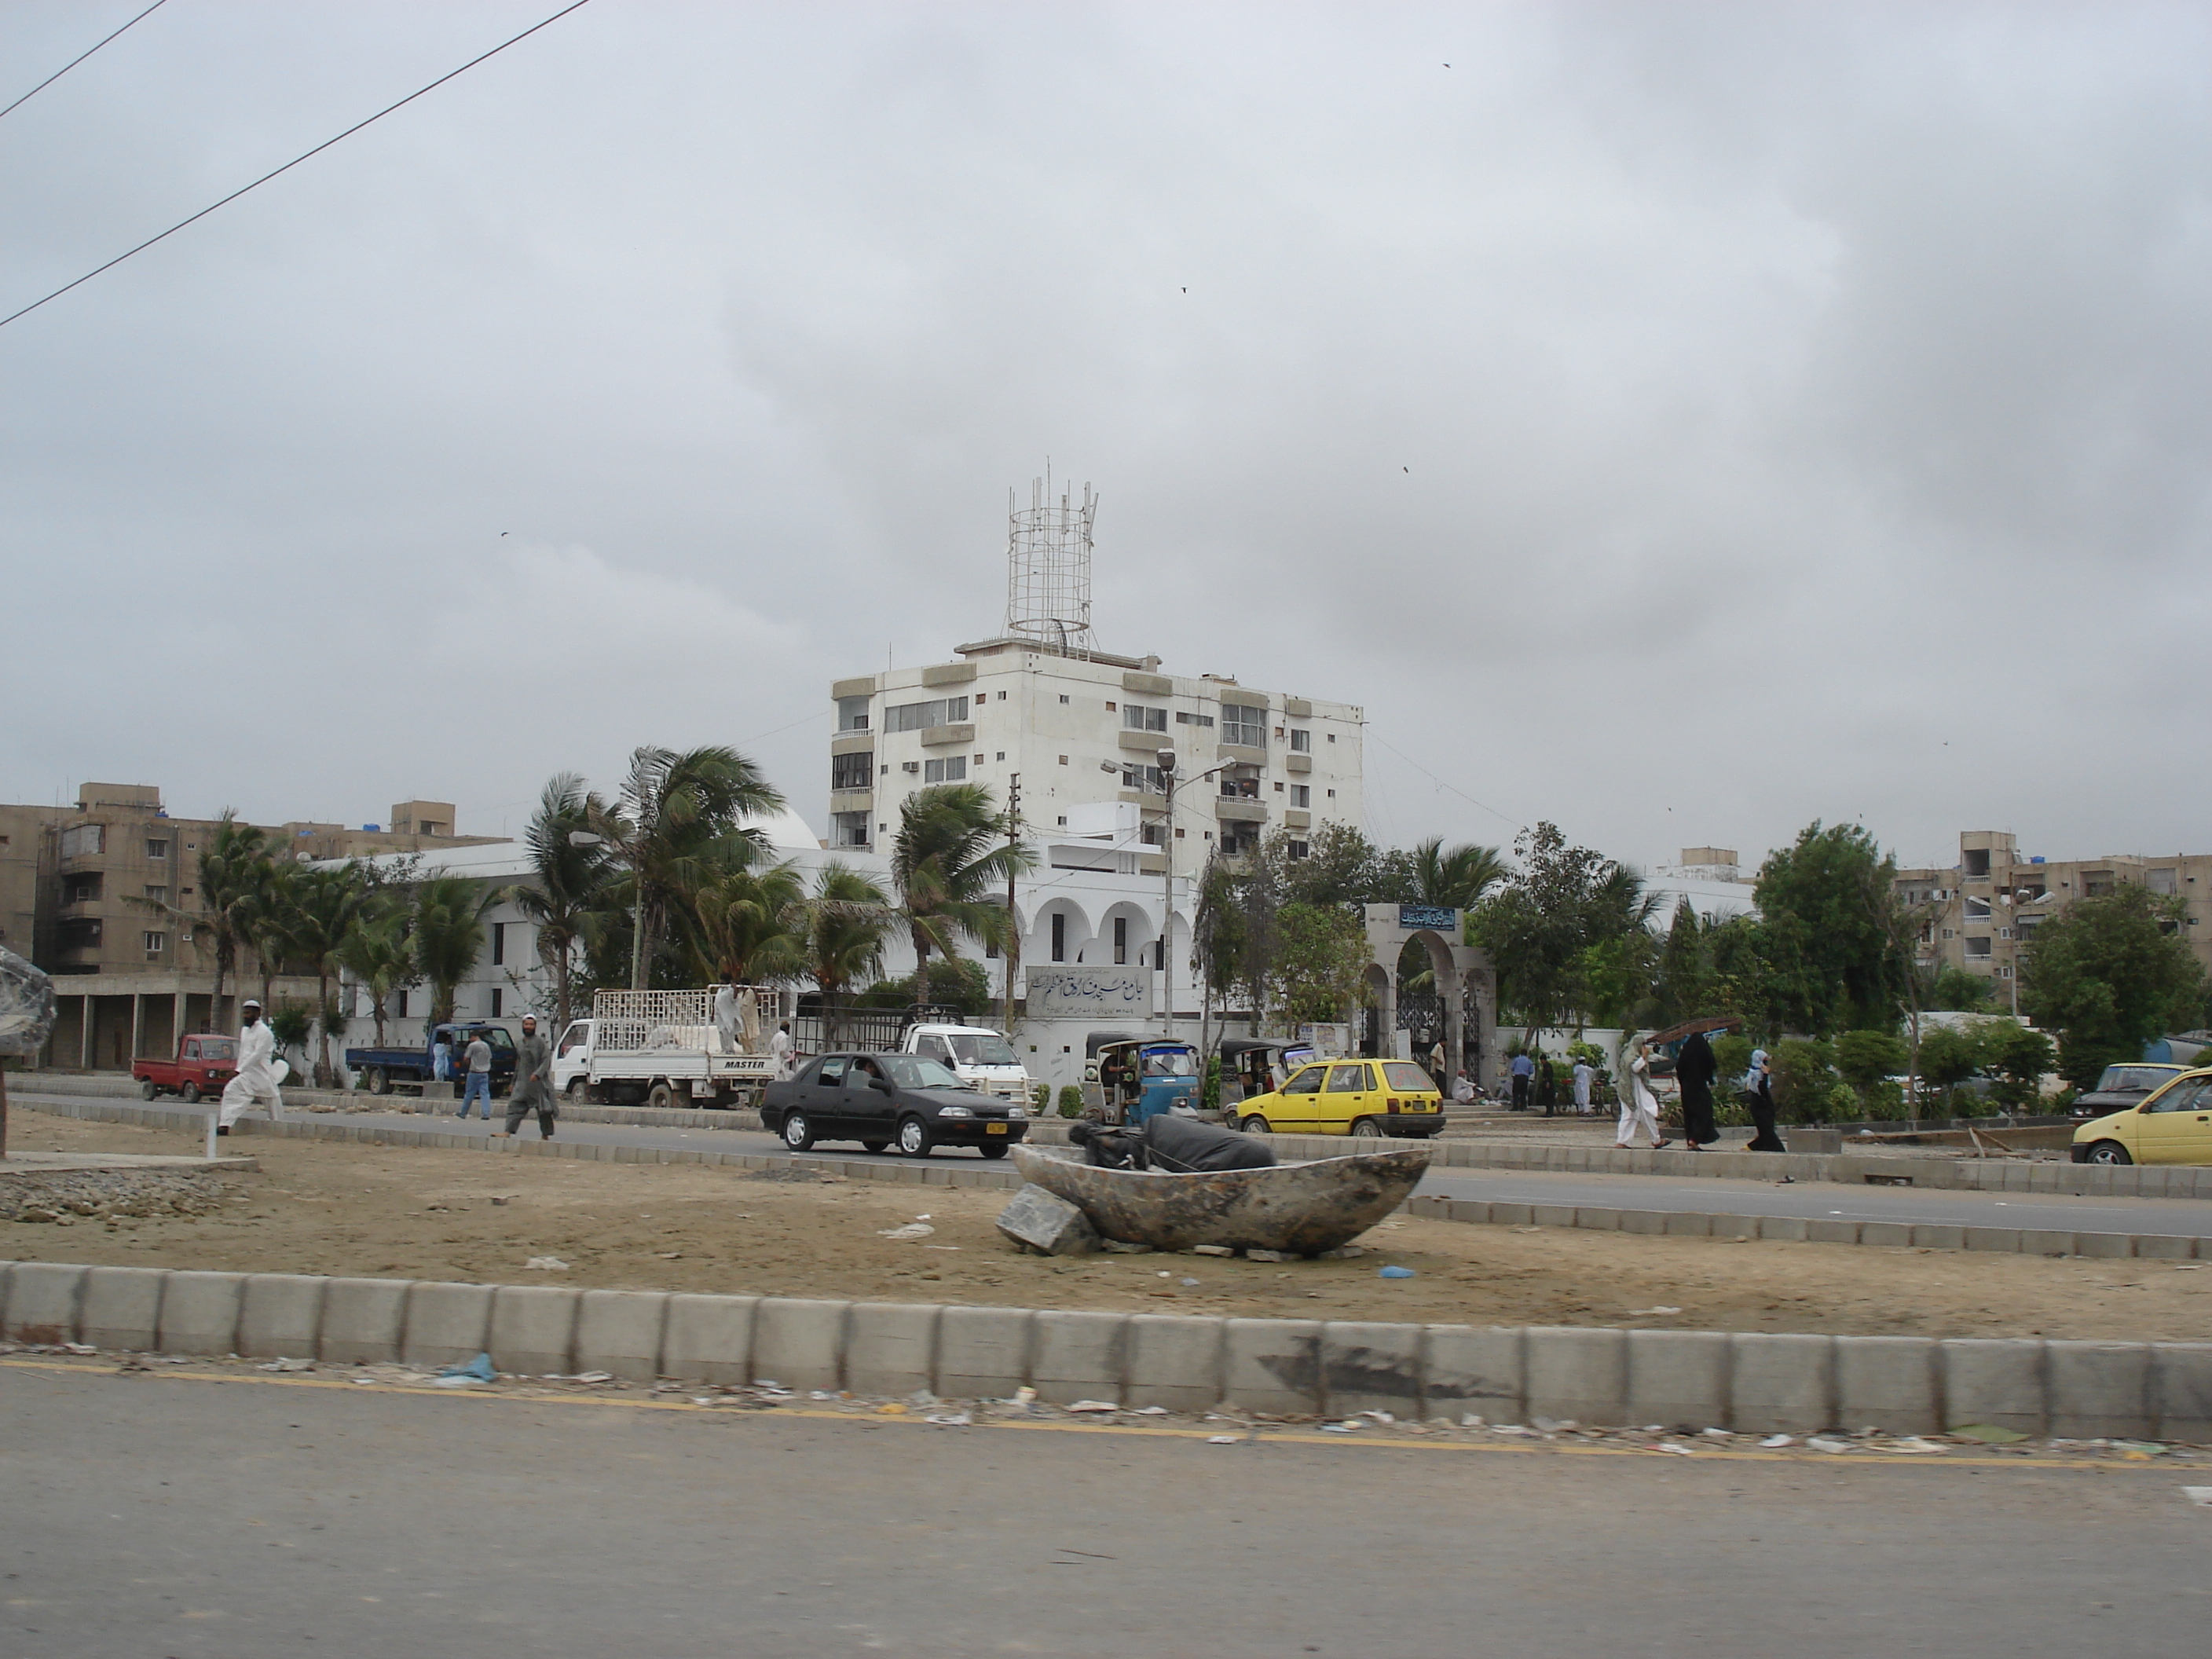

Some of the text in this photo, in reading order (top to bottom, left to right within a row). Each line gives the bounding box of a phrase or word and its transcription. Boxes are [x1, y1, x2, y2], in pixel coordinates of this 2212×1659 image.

[1063, 976, 1098, 997] فاروق
[1092, 977, 1126, 1001] مسجد
[1123, 975, 1144, 1001] جامع
[724, 1060, 765, 1069] MASTER
